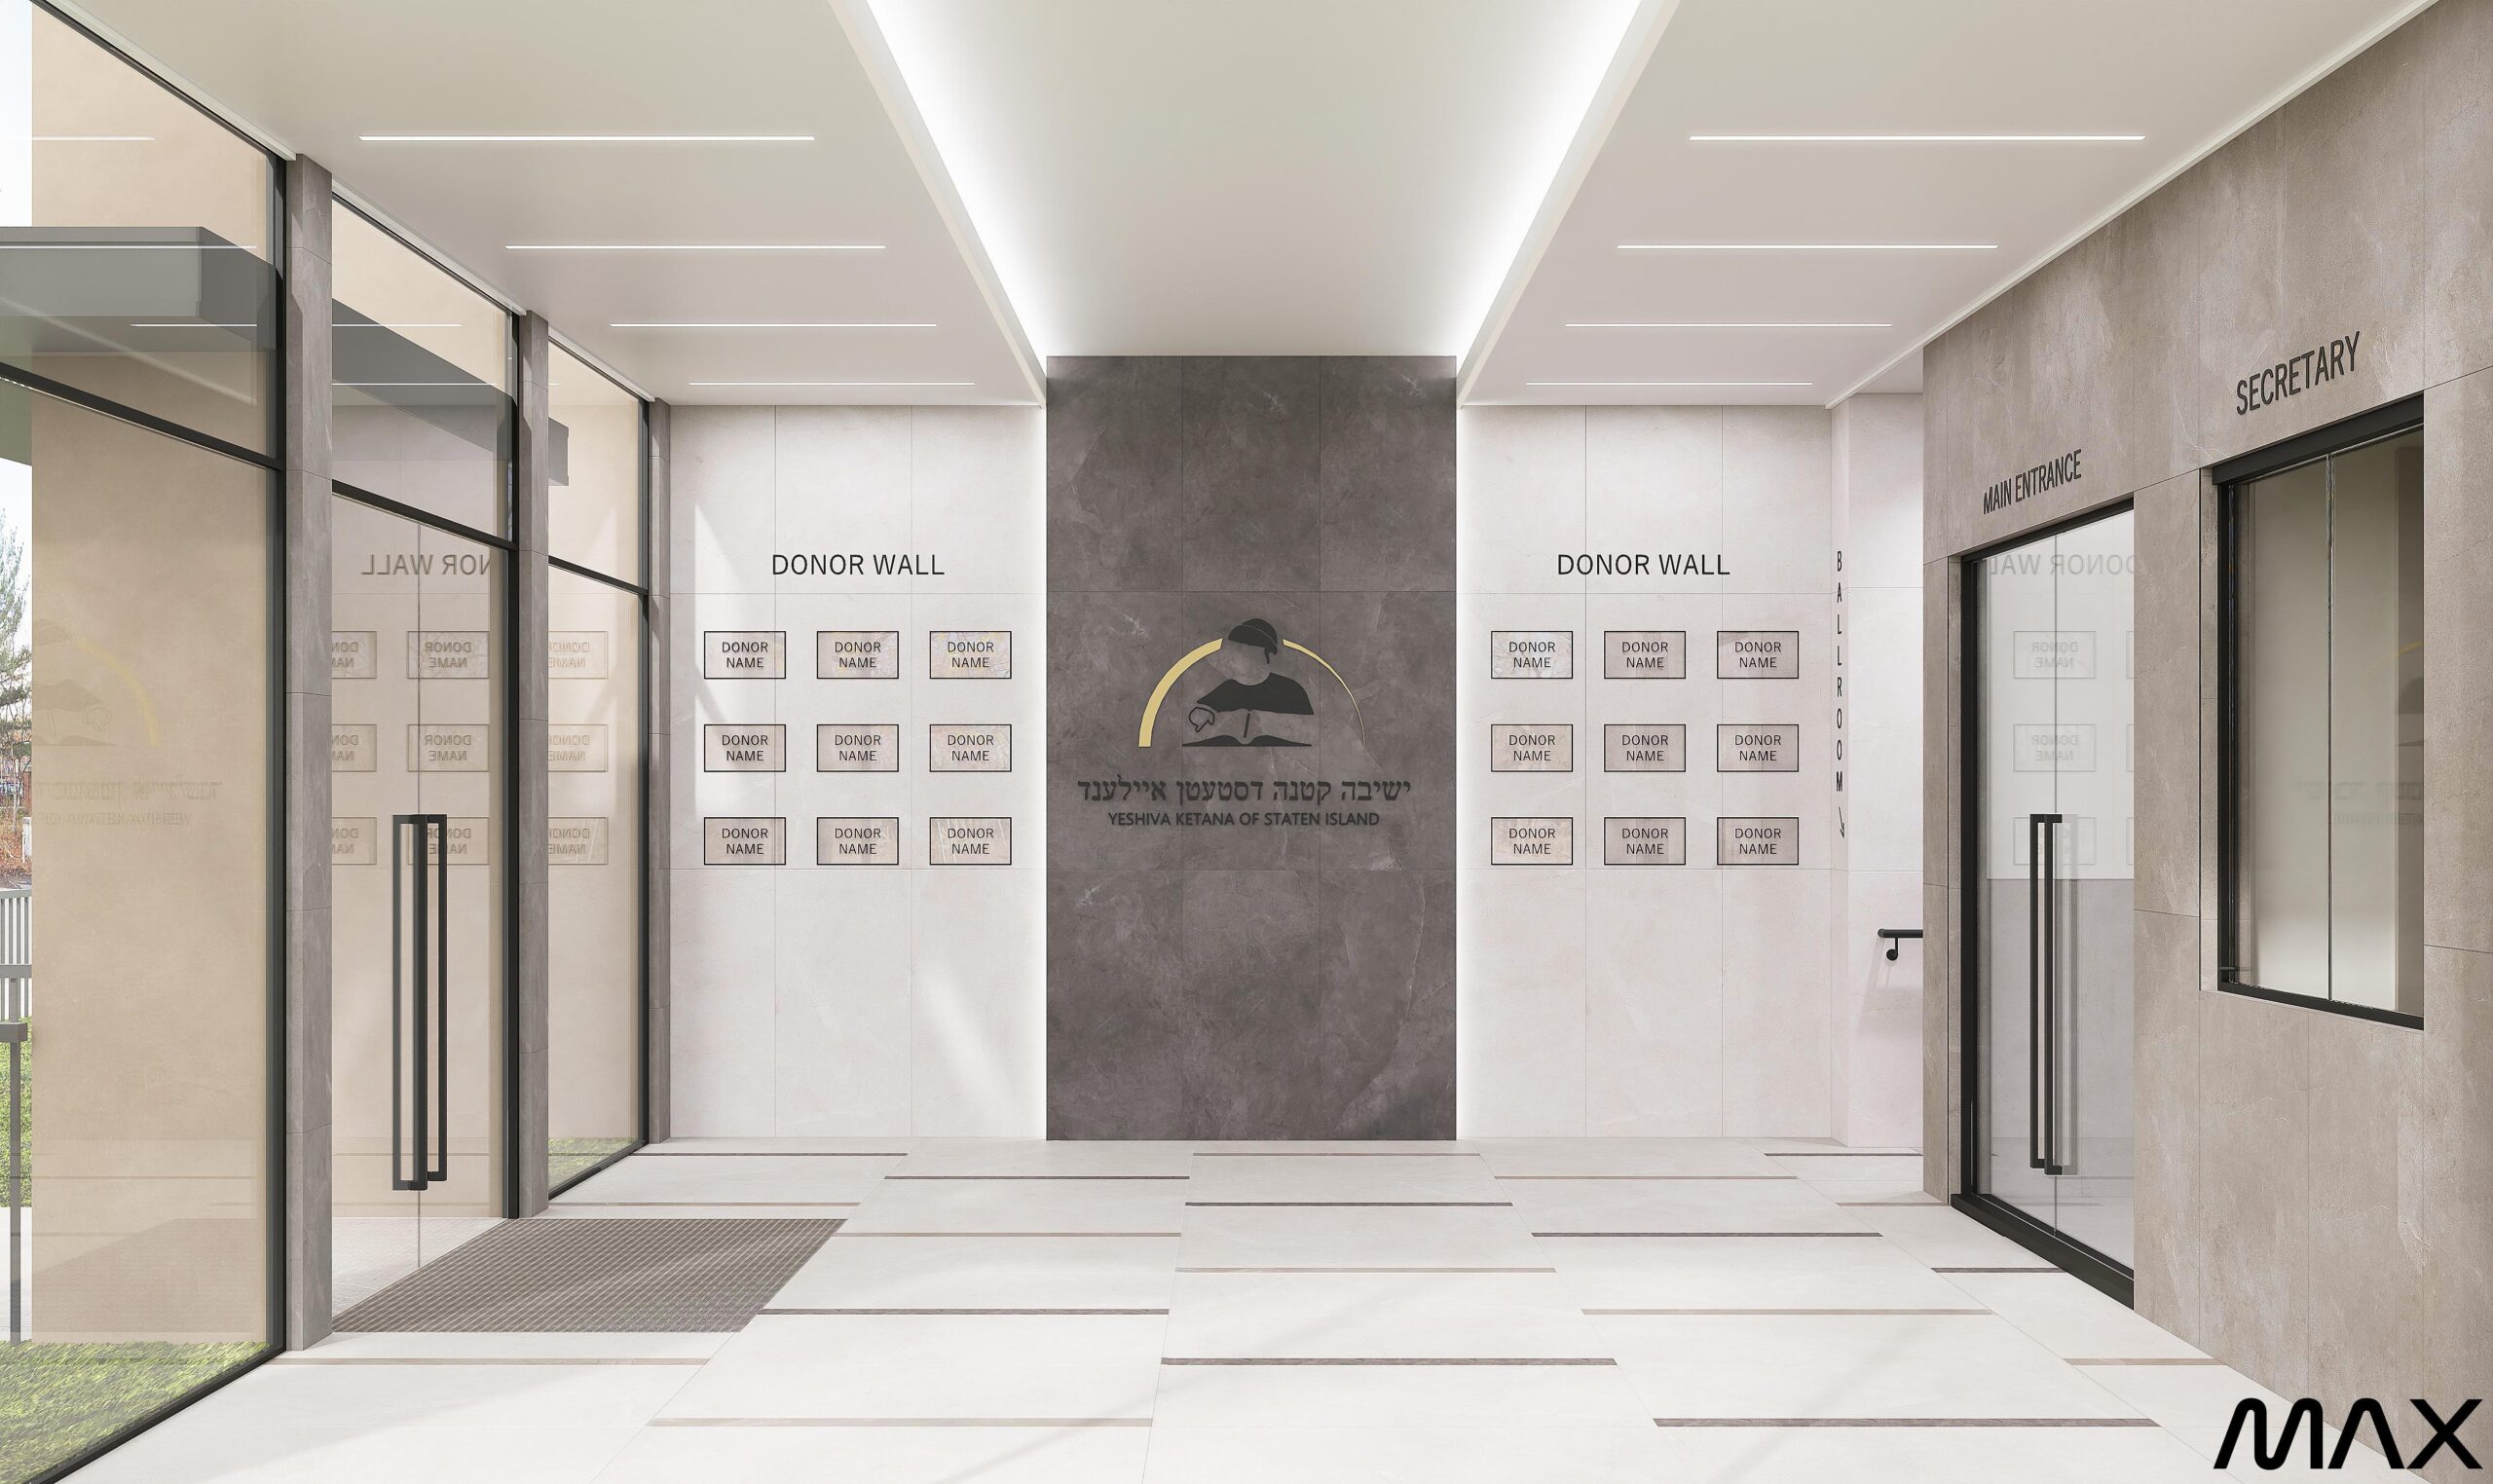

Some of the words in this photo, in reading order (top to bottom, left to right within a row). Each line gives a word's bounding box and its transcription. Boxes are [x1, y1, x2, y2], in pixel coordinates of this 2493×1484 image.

[2236, 331, 2362, 417] SECRETARY
[1983, 478, 2012, 514] MAIN
[2015, 449, 2082, 502] ENTRANCE
[772, 554, 864, 575] DONOR
[874, 554, 945, 575] WALL
[1557, 554, 1651, 575] DONOR
[1659, 554, 1730, 575] WALL
[722, 642, 768, 652] DONOR
[835, 642, 881, 652] DONOR
[948, 642, 994, 652] DONOR
[1508, 642, 1556, 652] DONOR
[1621, 642, 1668, 652] DONOR
[1734, 642, 1781, 652] DONOR
[726, 657, 763, 668] NAME
[838, 657, 876, 668] NAME
[951, 657, 989, 668] NAME
[1513, 657, 1551, 668] NAME
[1626, 657, 1664, 668] NAME
[1739, 657, 1777, 668] NAME
[722, 735, 768, 746] DONOR
[835, 735, 881, 746] DONOR
[948, 735, 994, 746] DONOR
[1508, 735, 1556, 746] DONOR
[1621, 735, 1668, 746] DONOR
[1734, 735, 1781, 746] DONOR
[726, 751, 763, 761] NAME
[838, 751, 876, 761] NAME
[951, 751, 989, 761] NAME
[1513, 750, 1551, 761] NAME
[1626, 750, 1664, 761] NAME
[1739, 750, 1777, 761] NAME
[1077, 774, 1167, 801] איילענד
[1176, 781, 1264, 805] דסטעטן
[1273, 781, 1331, 805] קטנה
[1341, 781, 1411, 801] ישיבה
[1108, 812, 1171, 826] YESHIVA
[1176, 812, 1235, 826] KETANA
[1239, 812, 1260, 826] OF
[1264, 812, 1321, 826] STATEN
[1325, 812, 1380, 826] ISLAND
[722, 828, 768, 838] DONOR
[835, 828, 881, 838] DONOR
[948, 828, 994, 838] DONOR
[1508, 828, 1556, 838] DONOR
[1621, 828, 1668, 838] DONOR
[1734, 828, 1781, 838] DONOR
[726, 843, 763, 854] NAME
[838, 843, 876, 854] NAME
[951, 843, 989, 854] NAME
[1513, 843, 1551, 854] NAME
[1626, 843, 1664, 854] NAME
[1739, 843, 1777, 854] NAME
